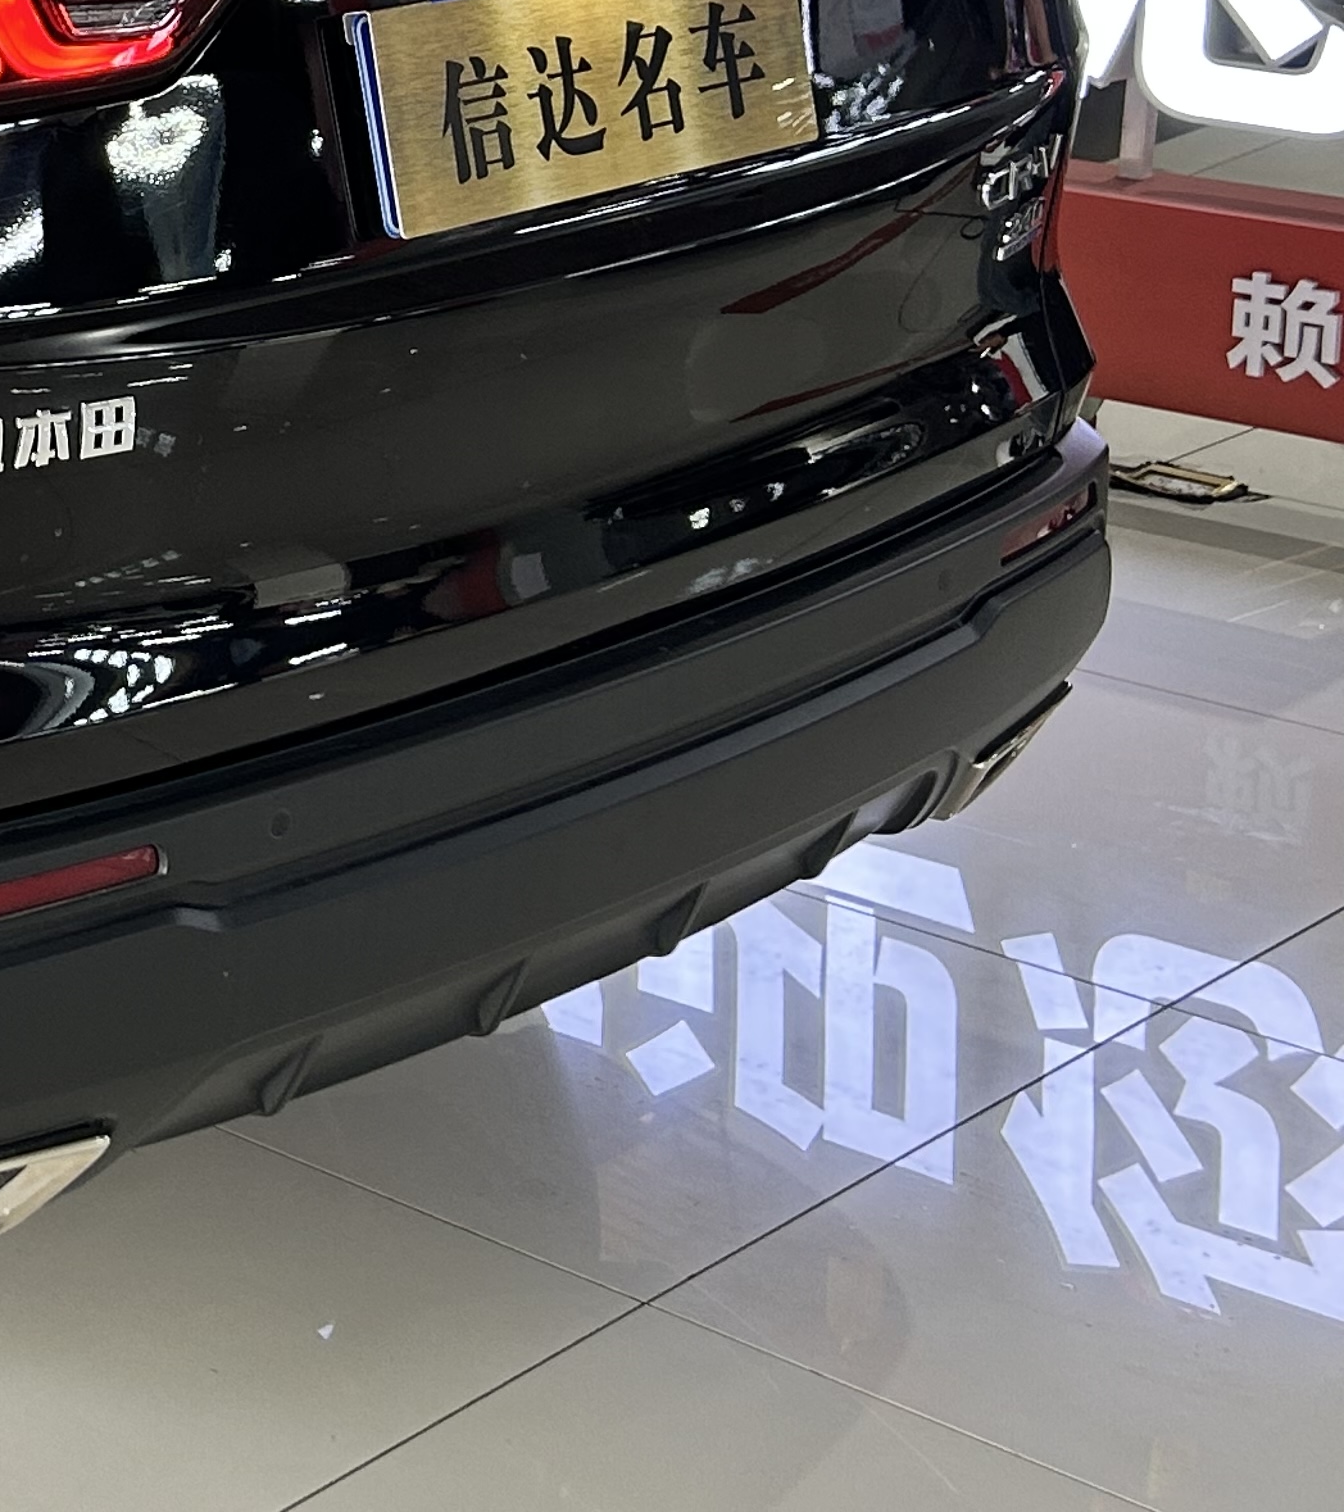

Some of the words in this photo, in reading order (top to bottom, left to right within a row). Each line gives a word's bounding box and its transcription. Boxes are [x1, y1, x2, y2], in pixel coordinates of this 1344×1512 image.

[442, 1, 766, 185] 信达名车
[1226, 270, 1343, 390] 赖
